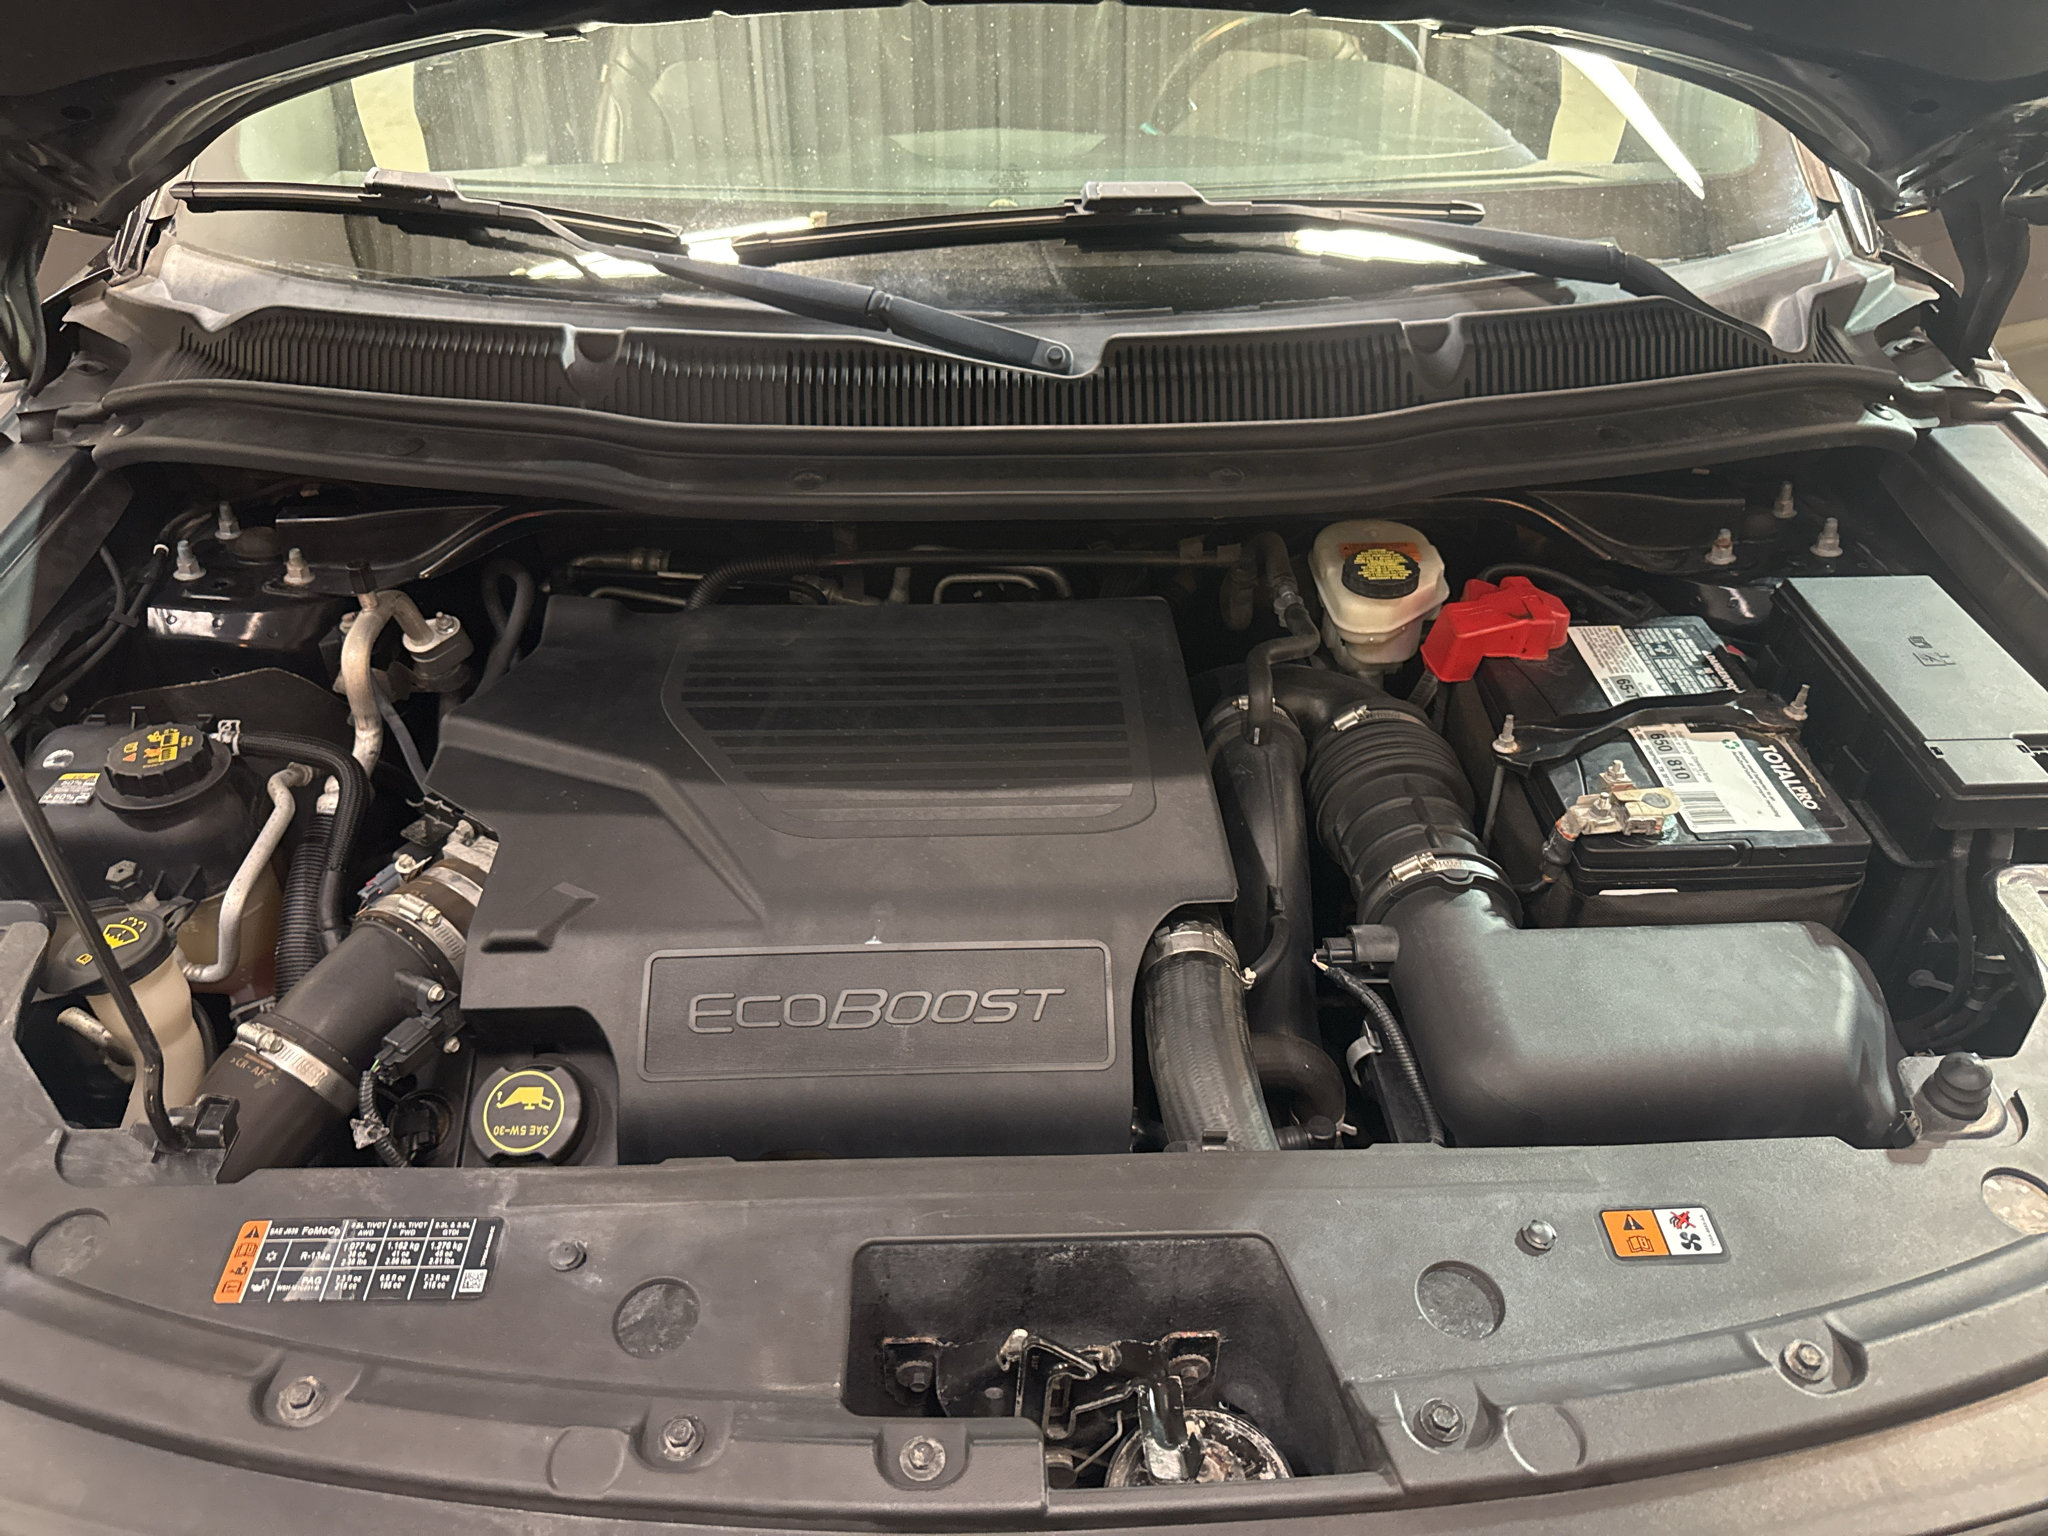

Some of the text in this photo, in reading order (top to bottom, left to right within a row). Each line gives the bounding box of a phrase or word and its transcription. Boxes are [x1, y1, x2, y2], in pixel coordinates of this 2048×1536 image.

[1650, 733, 1673, 752] 650
[1667, 759, 1690, 780] 810
[493, 1124, 550, 1136] SAE 5W-30
[301, 1225, 341, 1236] FoMoCo
[357, 1229, 375, 1237] AWD
[399, 1229, 416, 1237] FWD
[365, 1241, 377, 1253] kg
[409, 1241, 420, 1252] kg
[452, 1241, 463, 1252] kg
[301, 1276, 322, 1286] PAG
